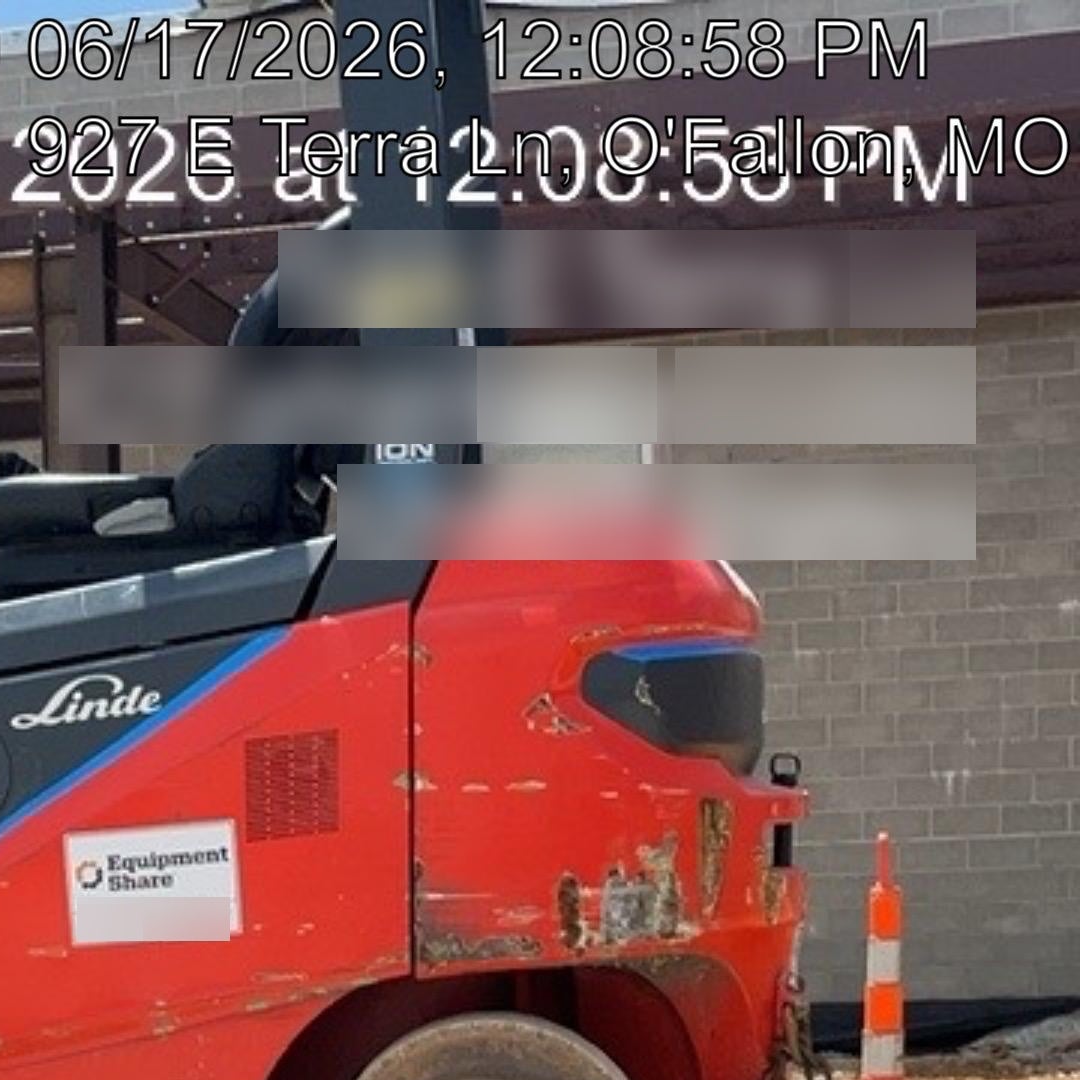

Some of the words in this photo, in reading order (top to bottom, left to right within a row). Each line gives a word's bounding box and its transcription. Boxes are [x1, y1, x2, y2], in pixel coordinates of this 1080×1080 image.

[10, 673, 161, 730] Linde
[107, 845, 229, 873] Equipment
[107, 874, 174, 892] Share
